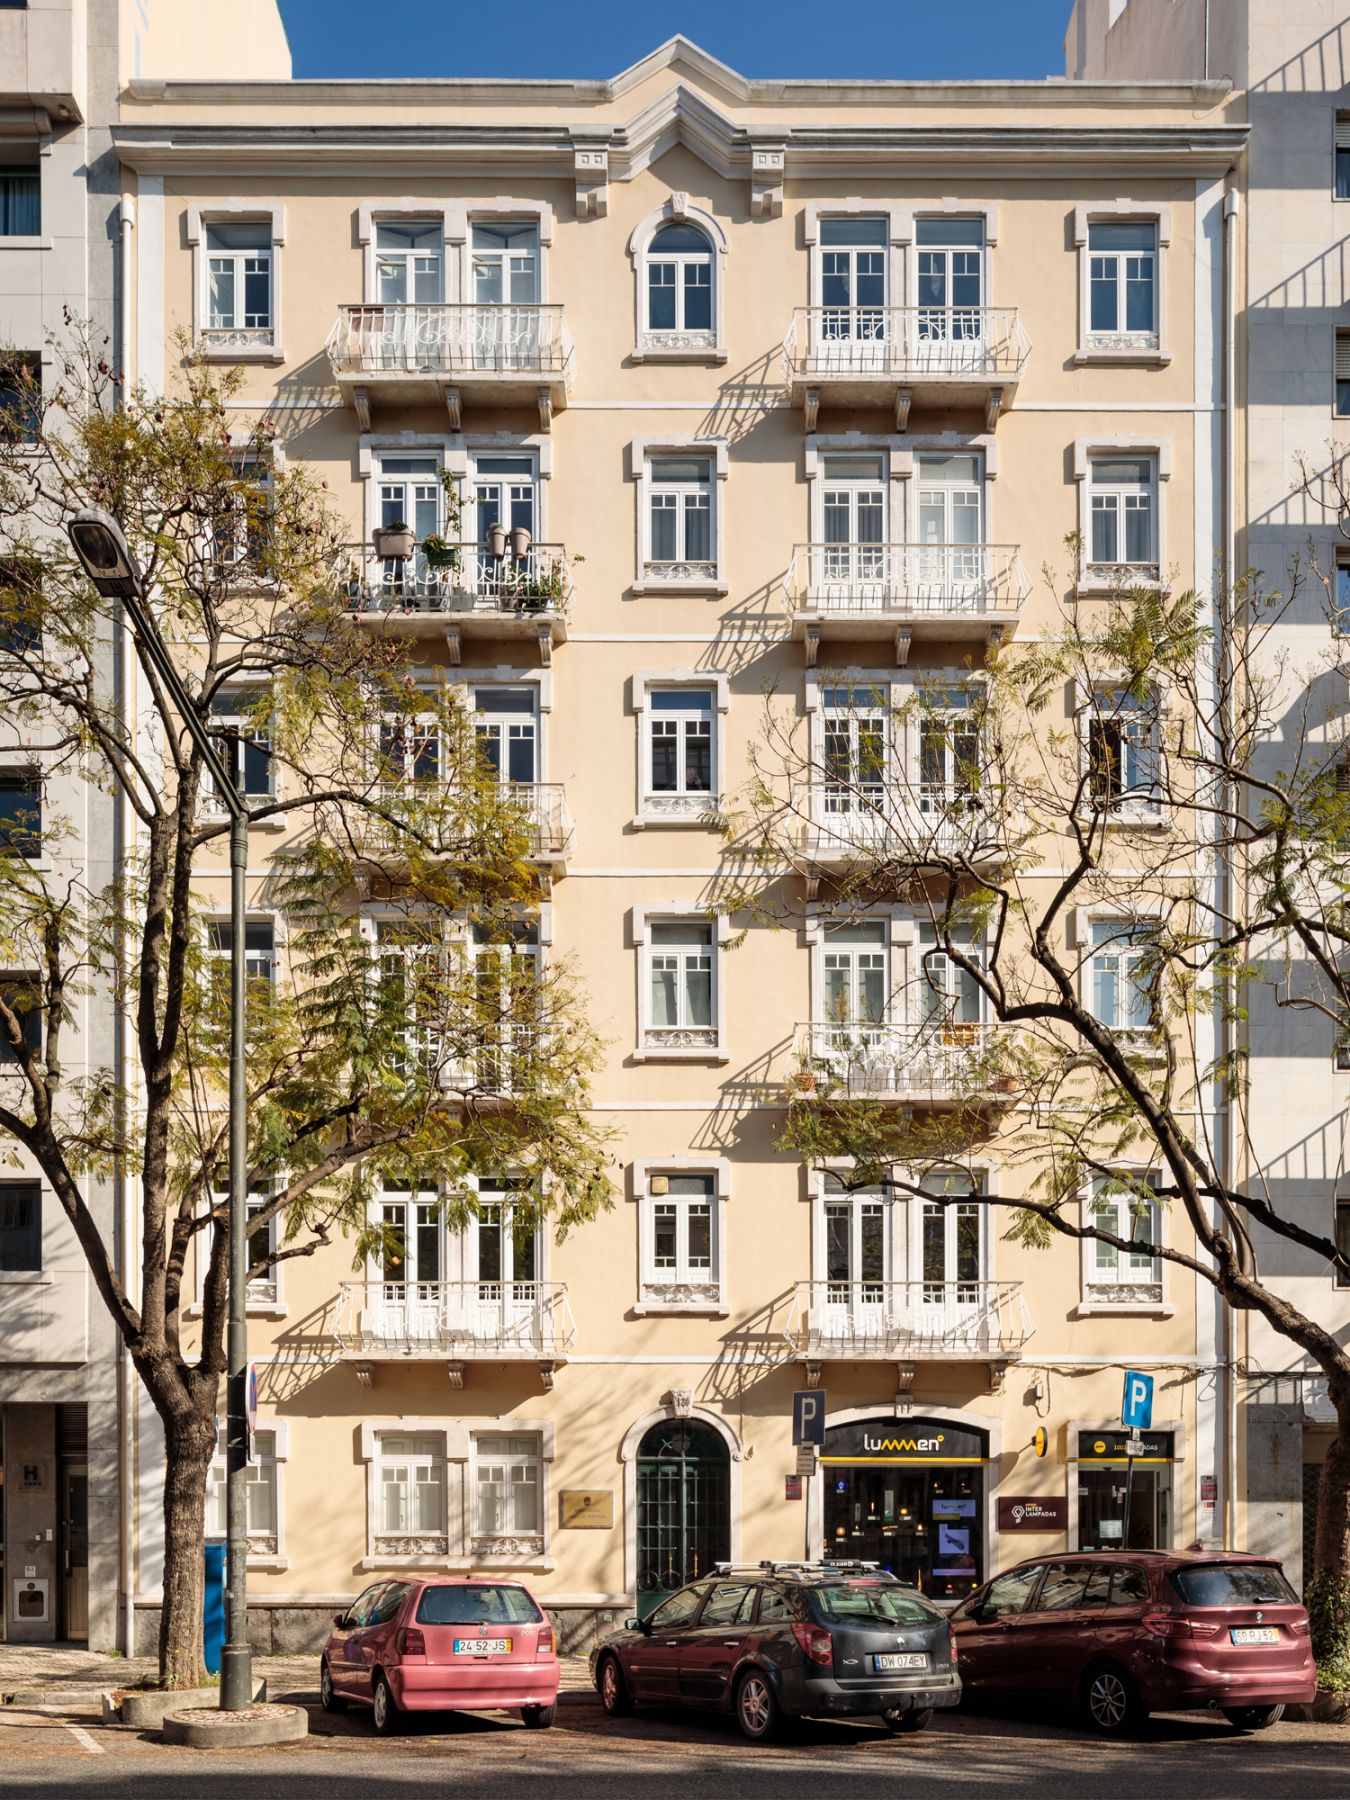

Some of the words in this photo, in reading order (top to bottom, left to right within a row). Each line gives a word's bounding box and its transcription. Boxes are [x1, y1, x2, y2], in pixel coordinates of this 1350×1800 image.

[1130, 1380, 1147, 1416] P
[801, 1397, 816, 1439] P
[881, 1656, 895, 1667] DW
